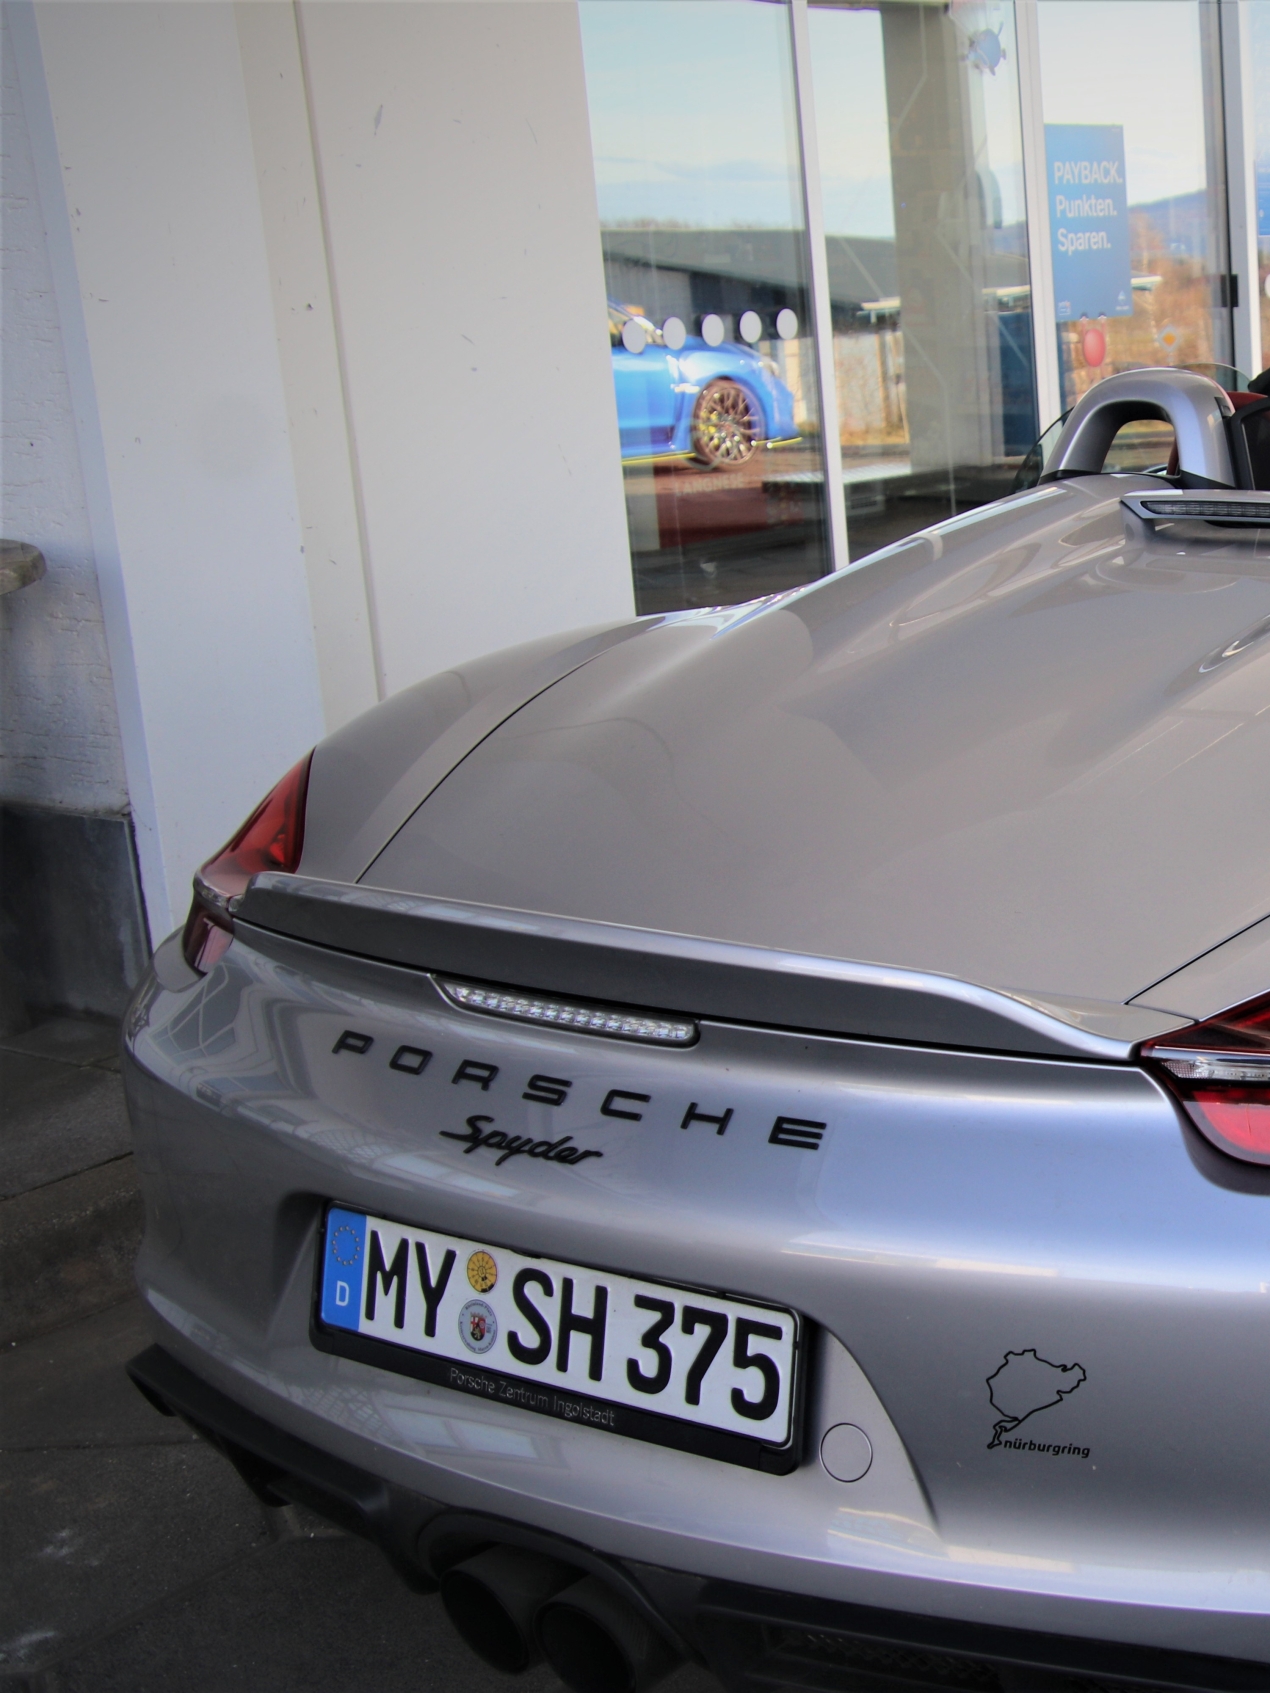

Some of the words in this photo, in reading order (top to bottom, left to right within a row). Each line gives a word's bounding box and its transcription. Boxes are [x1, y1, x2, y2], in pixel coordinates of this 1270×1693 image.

[1053, 161, 1123, 184] PAYBACK.
[1055, 194, 1118, 218] Punkten.
[1057, 228, 1112, 256] Sparen.
[332, 1029, 827, 1151] PORSCHE
[439, 1114, 603, 1166] Spyder
[335, 1281, 350, 1308] D
[365, 1229, 457, 1338] MY
[507, 1267, 608, 1382] SH
[626, 1294, 783, 1421] 375
[449, 1367, 496, 1394] Porsche
[500, 1381, 549, 1408] Zentrum
[553, 1395, 615, 1426] Ingolstadt
[1003, 1438, 1091, 1458] nürburgring
